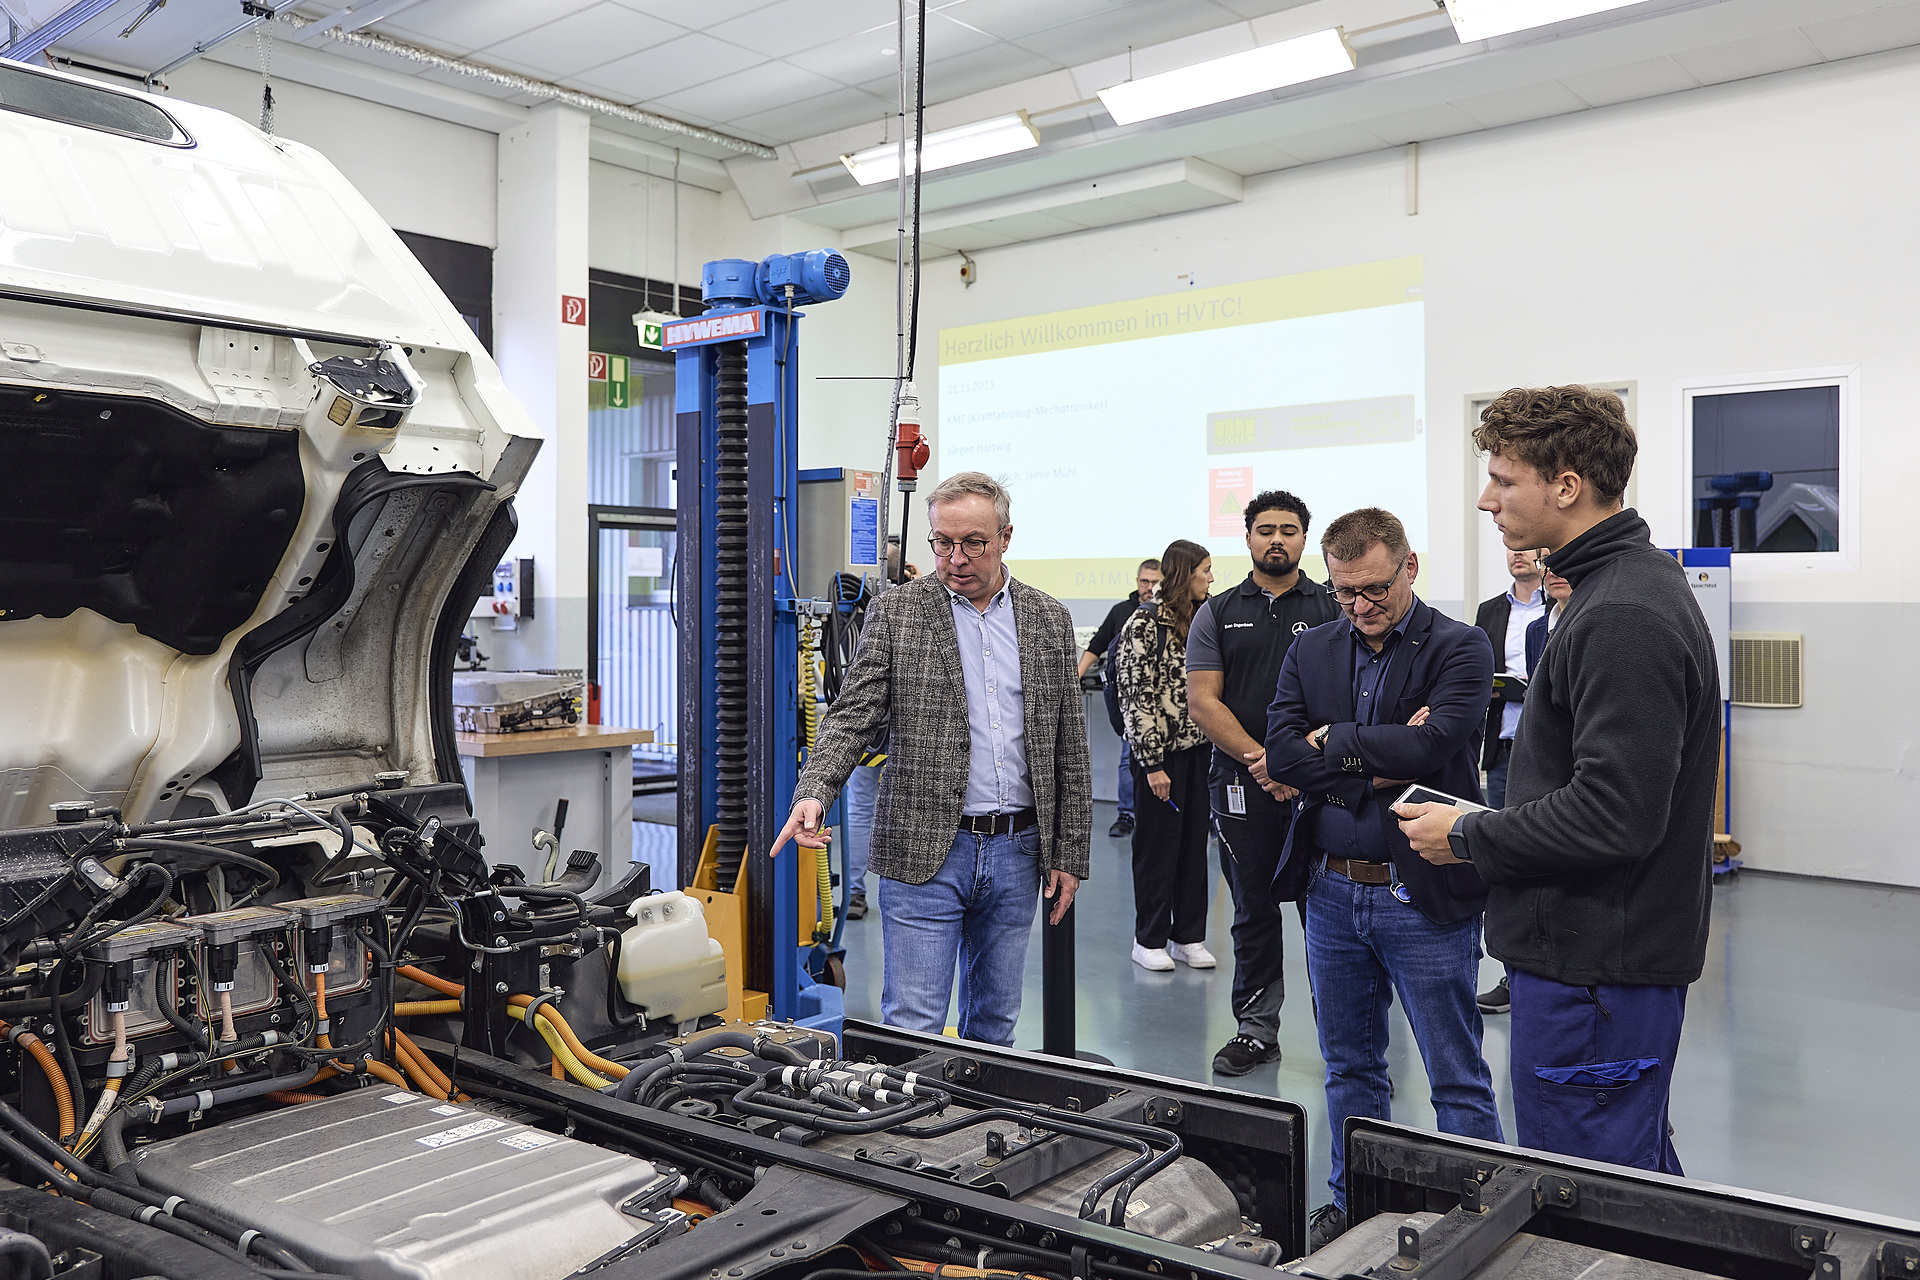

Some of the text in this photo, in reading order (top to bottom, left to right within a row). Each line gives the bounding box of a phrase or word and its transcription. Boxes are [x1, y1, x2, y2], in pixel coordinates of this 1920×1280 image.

[667, 313, 755, 345] HYWEMA
[945, 296, 1242, 357] Herzlich Willkommen im HVTC!
[947, 380, 995, 395] 21.11.2023
[946, 413, 966, 425] KMT
[947, 442, 1012, 457] Jürgen Hartwig
[1075, 571, 1133, 586] DAIML
